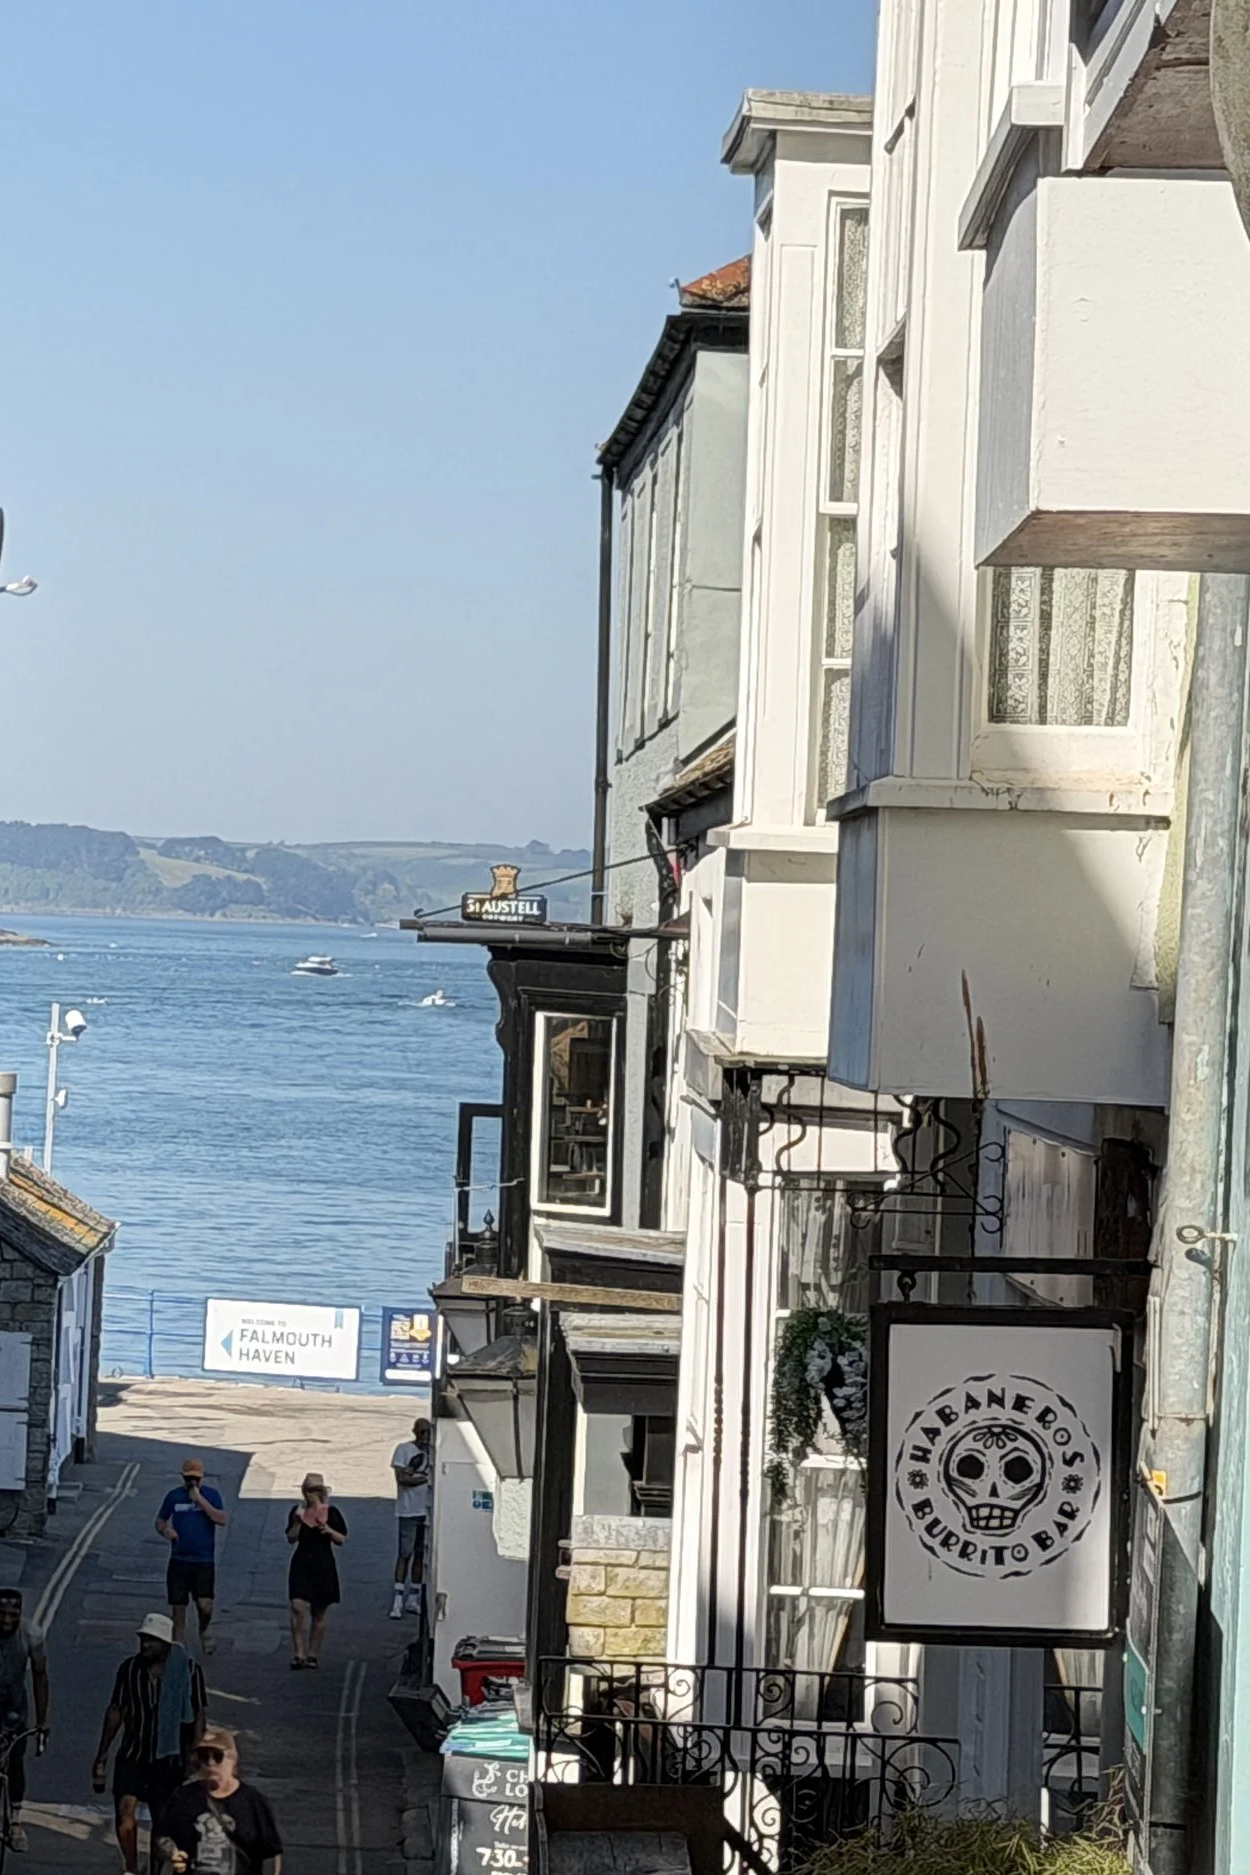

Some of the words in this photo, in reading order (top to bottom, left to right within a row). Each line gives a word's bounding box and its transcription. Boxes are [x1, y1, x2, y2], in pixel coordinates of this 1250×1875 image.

[481, 900, 542, 916] AUSTELL
[241, 1318, 275, 1326] WELCOME
[239, 1328, 333, 1348] FALMOUTH
[238, 1347, 296, 1365] HAVEN
[909, 1387, 1086, 1467] HABANEROS
[911, 1498, 1030, 1567] BURRITO
[1031, 1501, 1081, 1552] BAR
